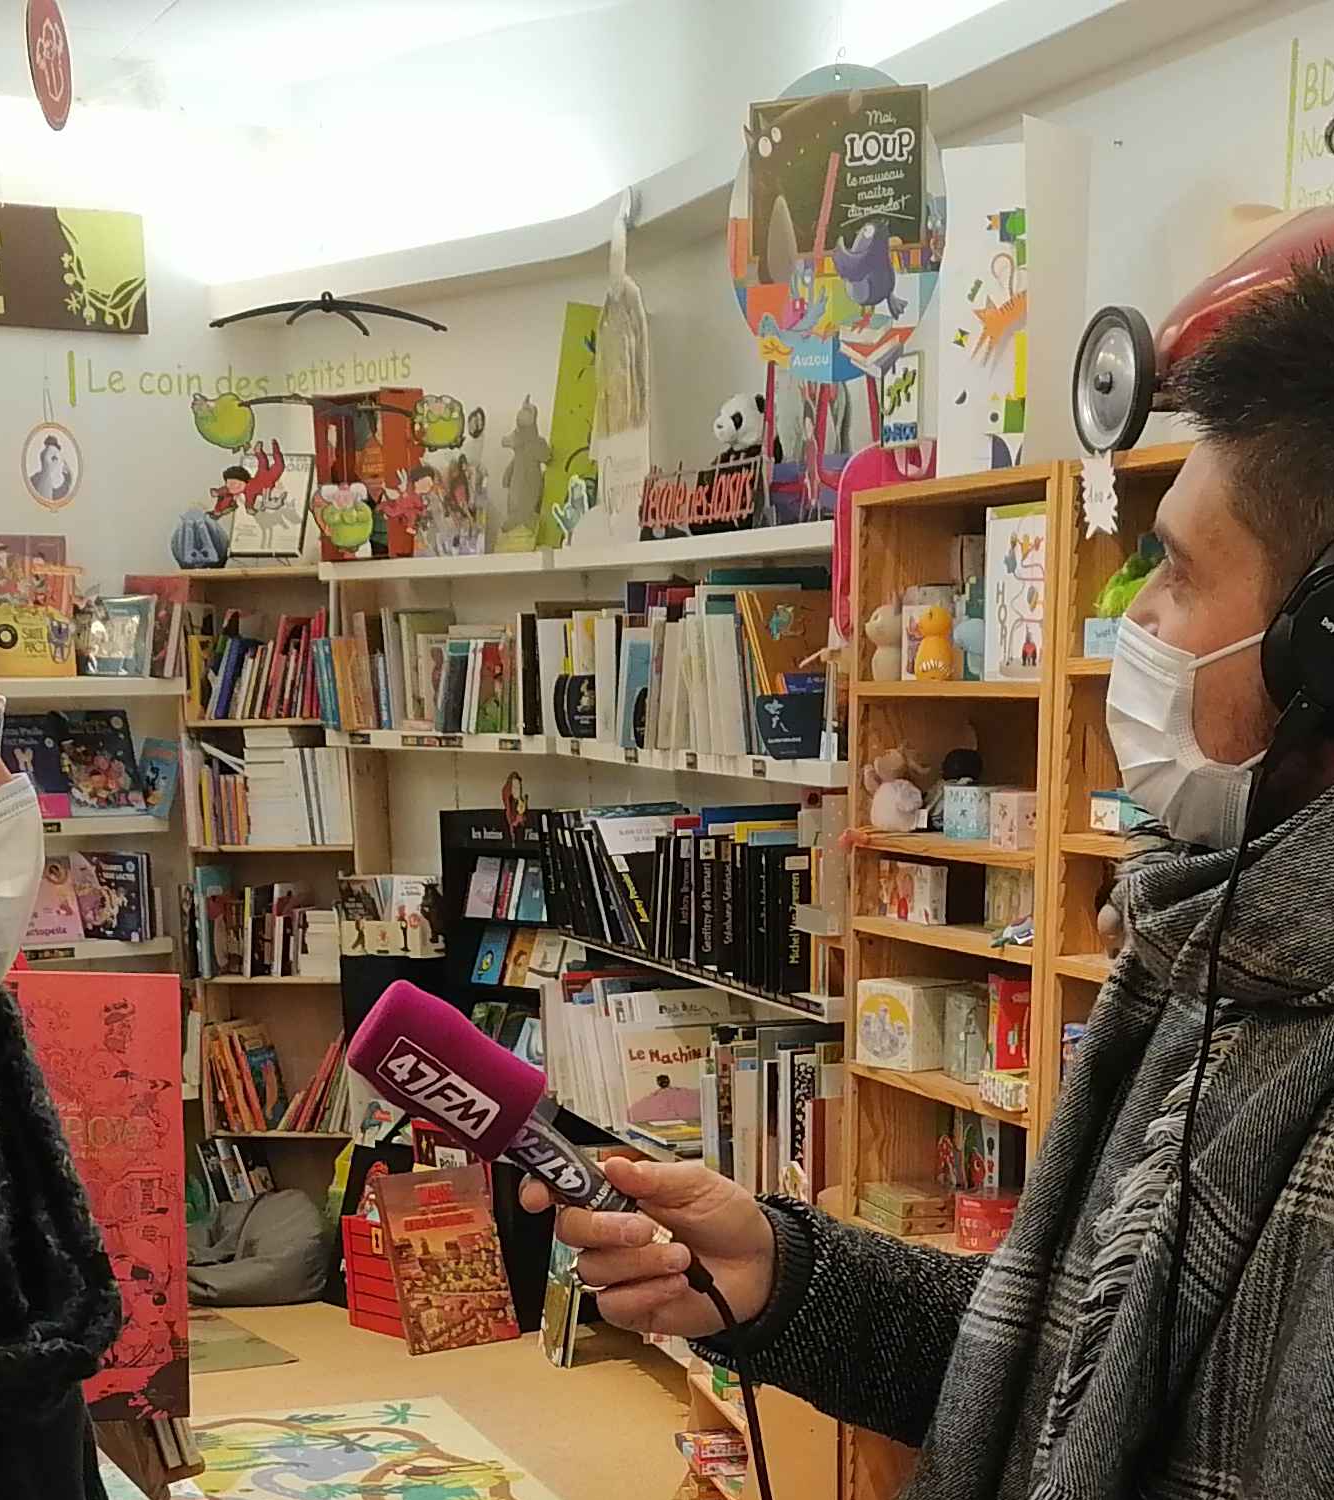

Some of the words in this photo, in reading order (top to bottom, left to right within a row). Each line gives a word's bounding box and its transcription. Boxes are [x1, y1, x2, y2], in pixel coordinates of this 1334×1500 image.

[844, 129, 915, 166] LOUP,
[87, 359, 126, 393] Le
[139, 365, 202, 396] coin
[217, 365, 269, 397] des
[285, 361, 347, 397] petits
[354, 350, 412, 387] bouts
[788, 933, 800, 965] Michel
[629, 1048, 645, 1061] Le
[648, 1045, 702, 1064] Machin
[386, 1053, 492, 1133] 47FM
